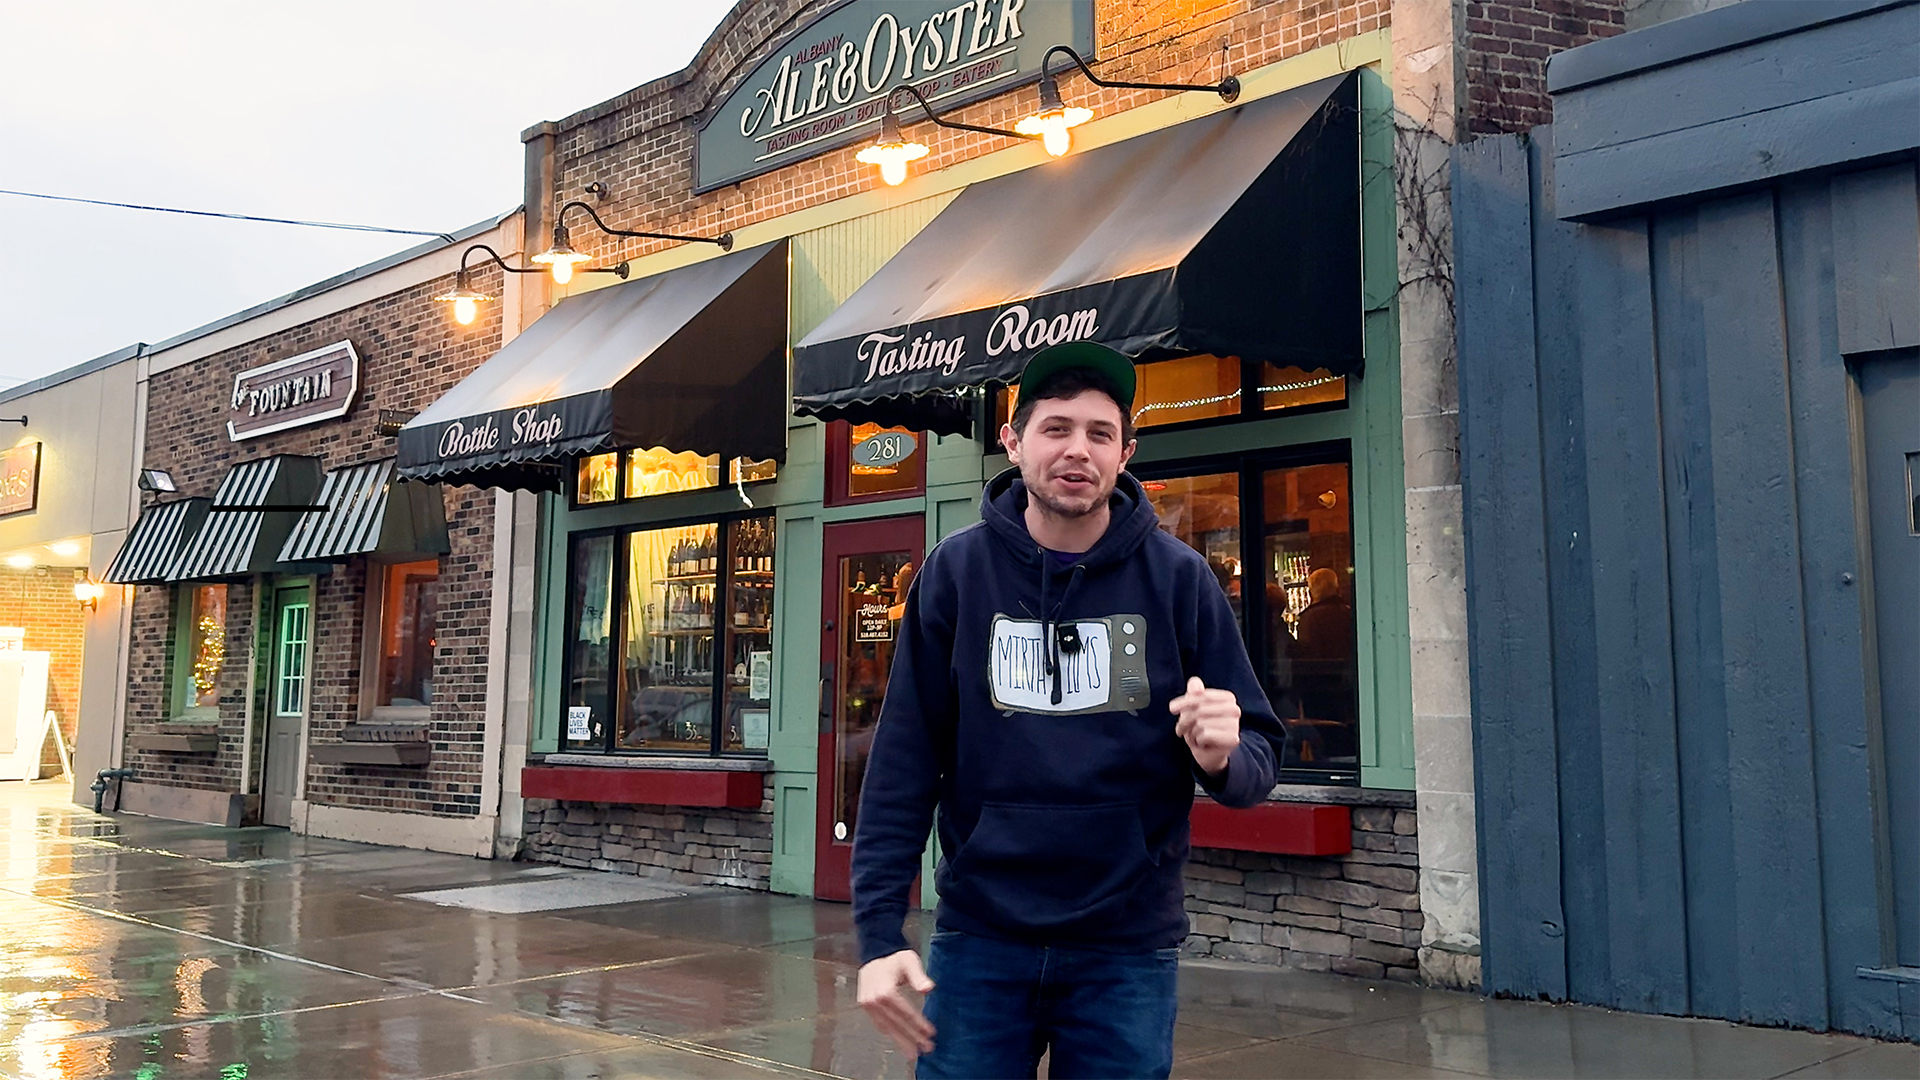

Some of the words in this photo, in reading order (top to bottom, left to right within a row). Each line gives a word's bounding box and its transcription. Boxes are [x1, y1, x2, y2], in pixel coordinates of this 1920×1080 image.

[794, 33, 845, 67] ALBANY
[765, 127, 810, 153] TASTING
[812, 114, 847, 138] ROOM
[856, 92, 902, 121] BOTTE
[952, 58, 1004, 88] EATERY
[857, 331, 967, 383] Tasting
[985, 304, 1100, 357] Room
[248, 368, 332, 417] FOUNTAIN
[438, 416, 500, 458] Bottle
[511, 408, 563, 448] Shop
[867, 435, 901, 461] 281
[861, 603, 887, 617] Hours
[569, 711, 587, 719] BLACK
[569, 719, 584, 727] LIVES
[568, 727, 589, 735] MATTER
